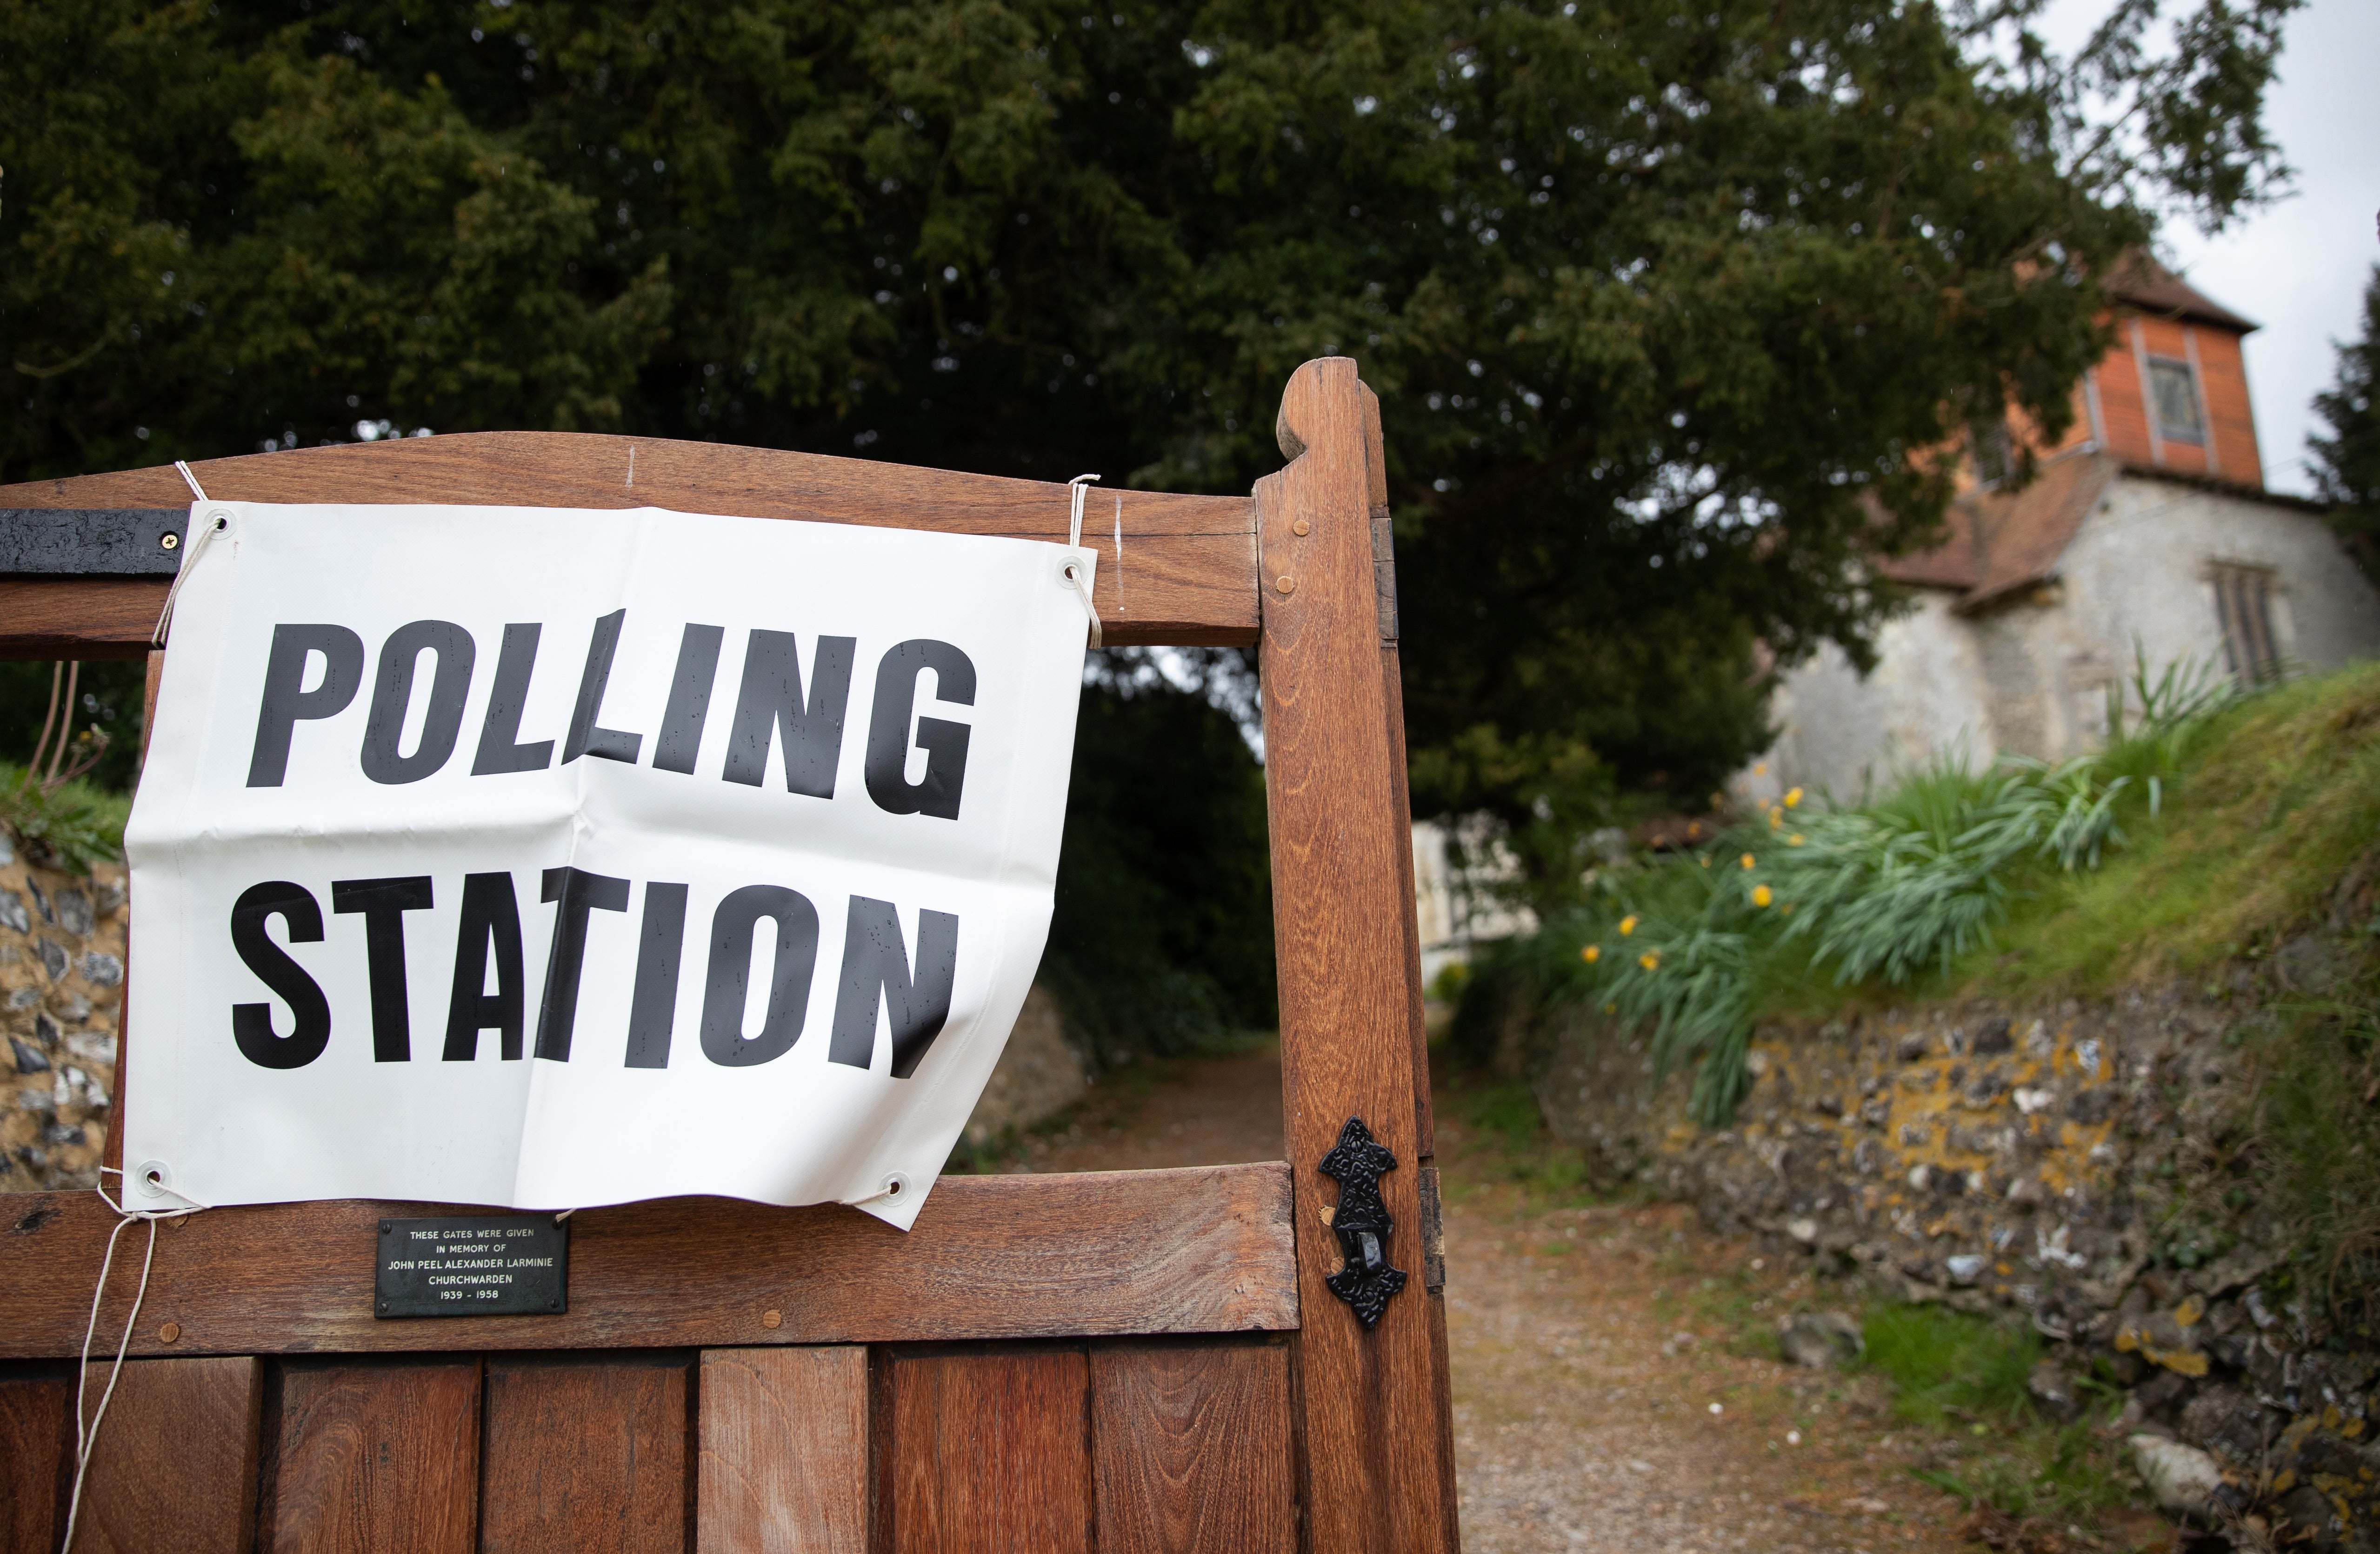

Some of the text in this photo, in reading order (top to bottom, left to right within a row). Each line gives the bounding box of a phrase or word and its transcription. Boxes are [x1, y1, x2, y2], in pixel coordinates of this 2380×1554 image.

[246, 608, 977, 821] POLLING
[231, 866, 960, 1080] STATION
[410, 1228, 534, 1239] THESE GATES WERE GIVEN
[436, 1244, 506, 1254] IN MEMORY OF
[388, 1258, 553, 1270] JOHN PEEL ALEXANDER LARMINIE
[428, 1274, 513, 1285] CHURCHWARDEN
[440, 1291, 462, 1300] 1939
[476, 1290, 499, 1299] 1958
